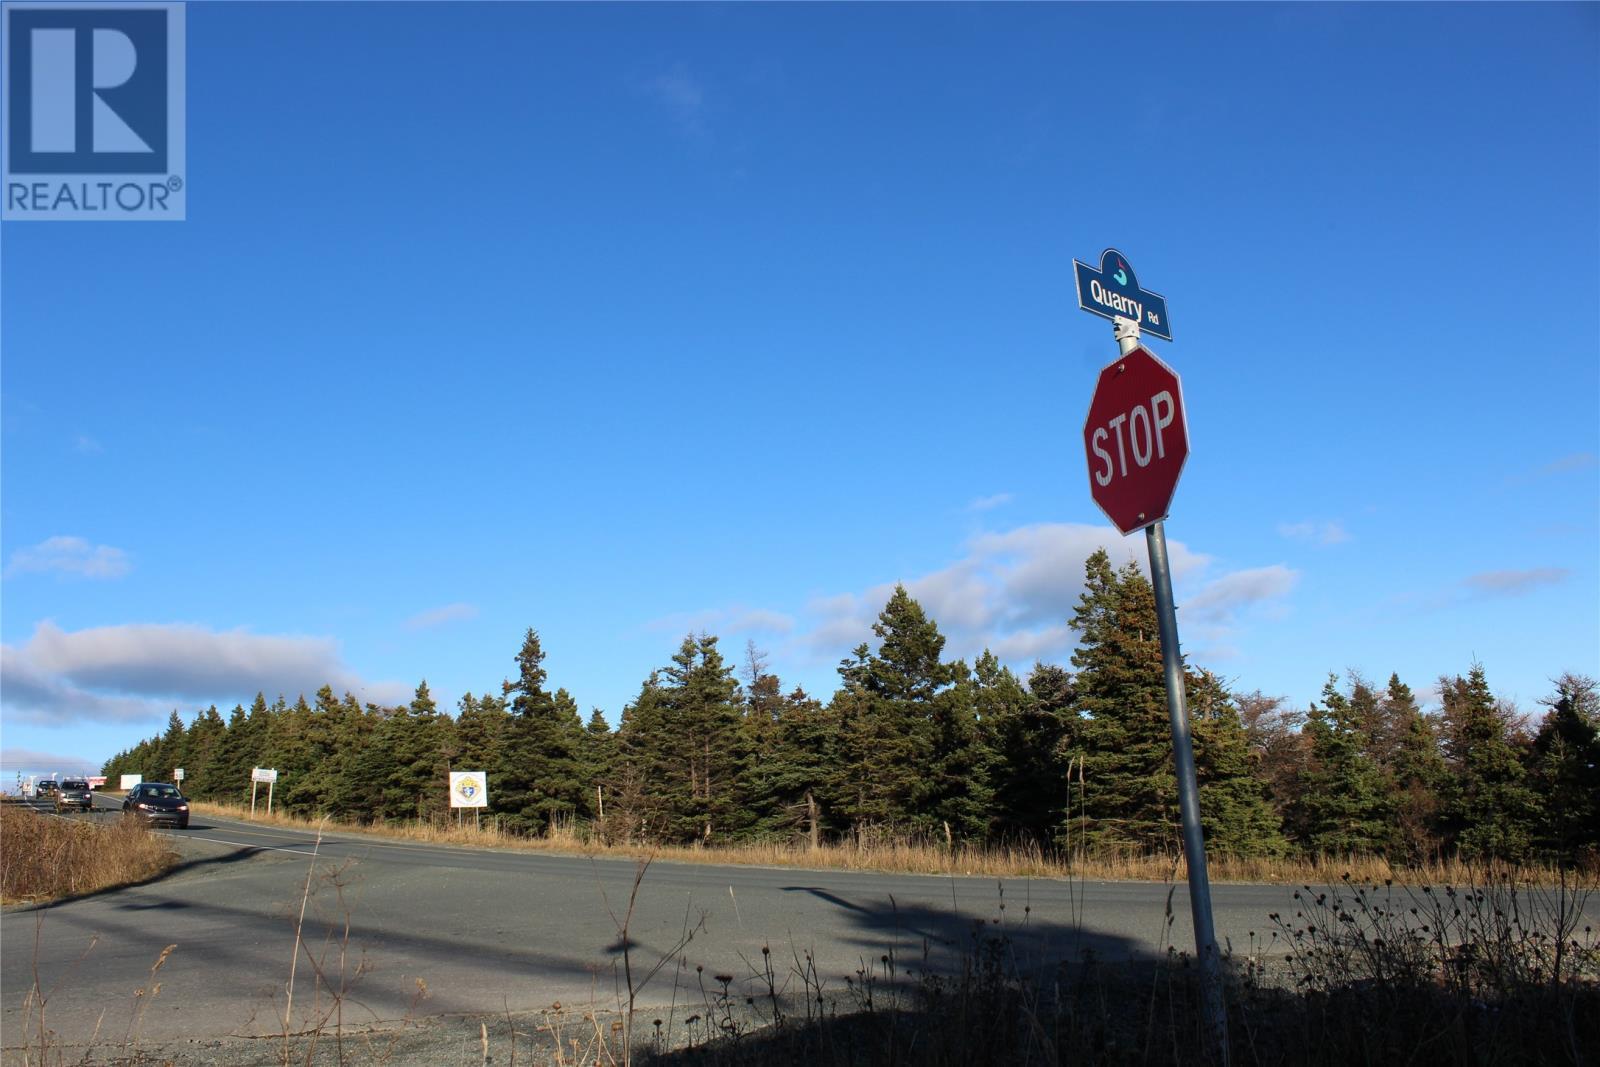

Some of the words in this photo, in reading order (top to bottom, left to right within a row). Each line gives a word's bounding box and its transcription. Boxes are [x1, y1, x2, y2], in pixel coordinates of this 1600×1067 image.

[1090, 279, 1142, 322] Quarry
[1147, 311, 1160, 325] Rd
[1092, 390, 1175, 487] STOP
